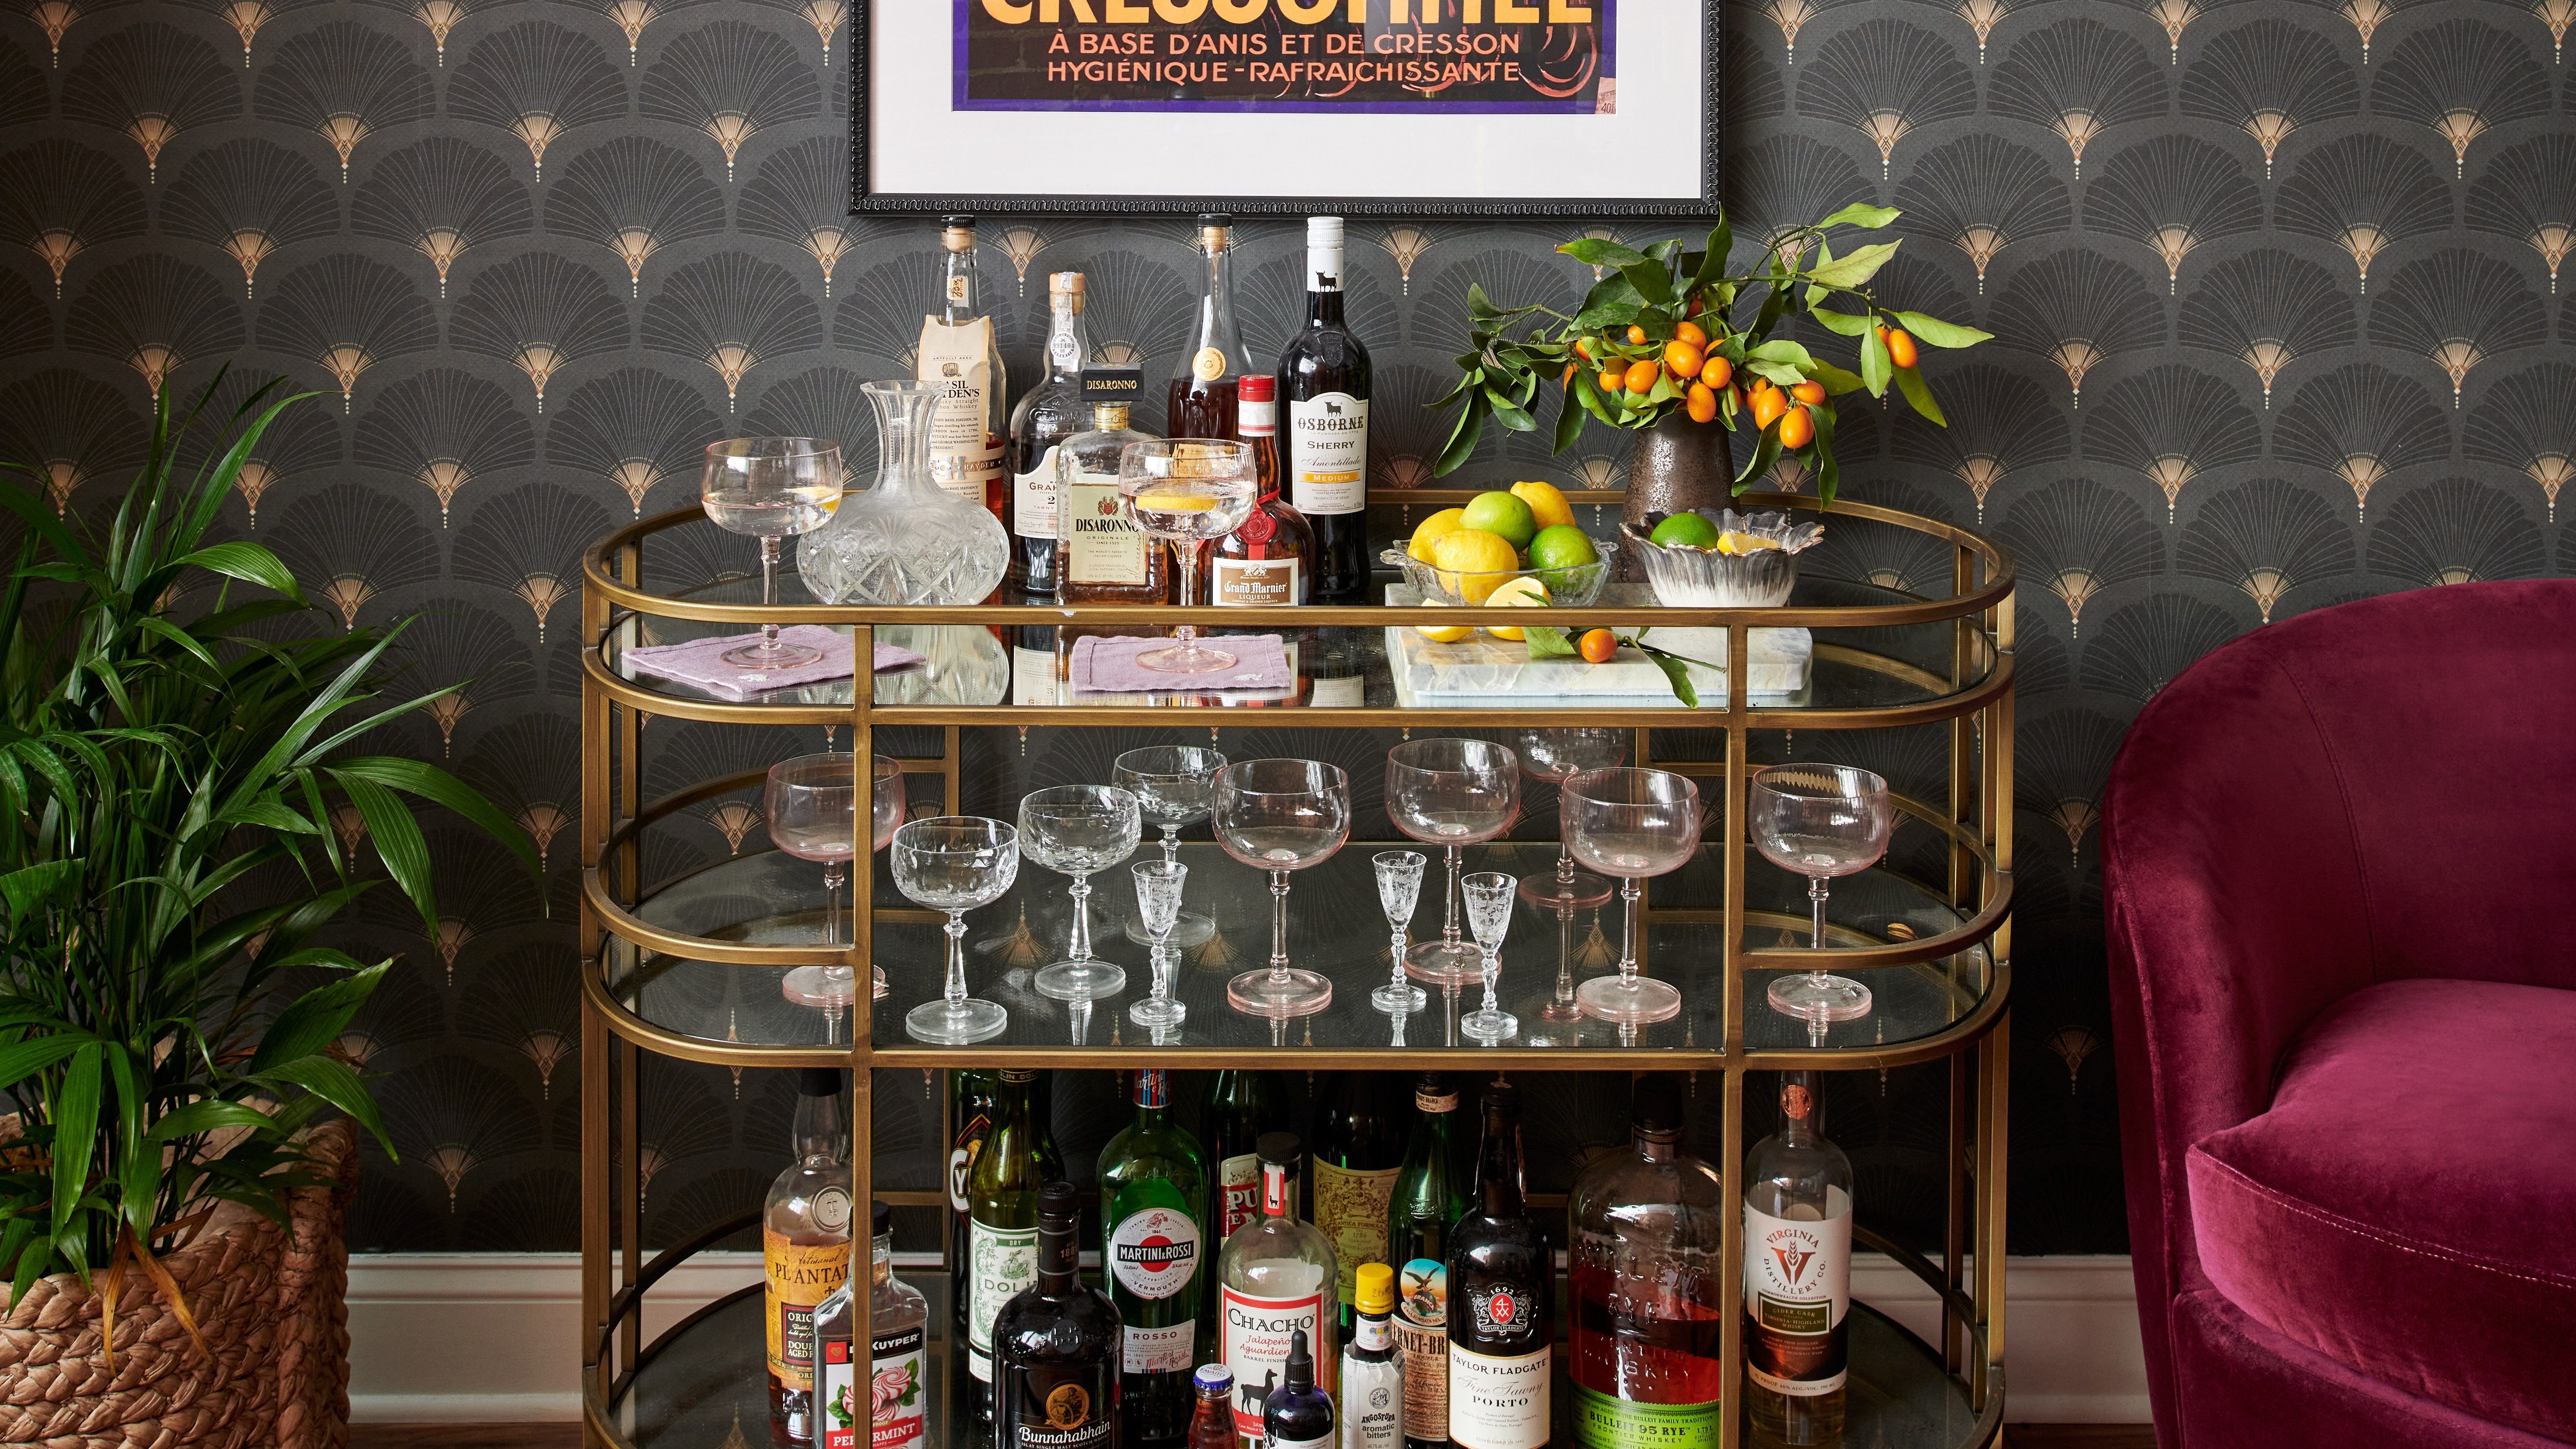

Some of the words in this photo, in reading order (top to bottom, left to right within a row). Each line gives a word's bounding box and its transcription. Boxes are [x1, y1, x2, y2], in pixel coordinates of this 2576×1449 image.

[1048, 28, 1070, 54] À
[1080, 33, 1155, 54] BASE
[1170, 33, 1267, 54] D'ANIS
[1282, 34, 1314, 54] ET
[1326, 34, 1362, 54] DE
[1374, 33, 1519, 54] CRESSON
[946, 380, 969, 389] SIL
[1087, 380, 1138, 390] DISARONNO
[943, 389, 980, 398] DEN'S
[1297, 416, 1364, 431] OSBORNE
[1308, 441, 1355, 449] SHERRY
[964, 461, 995, 470] HAYDEN
[1301, 456, 1361, 467] Amontillado
[1029, 482, 1057, 491] GRAH
[1224, 580, 1250, 594] Grand
[1250, 581, 1287, 594] Marnier
[1766, 1228, 1819, 1249] VIRGINIA
[785, 1248, 842, 1265] Artisanal
[775, 1262, 849, 1284] PLANTAT
[1764, 1258, 1817, 1294] DISTILLERY
[1817, 1261, 1826, 1278] CO.
[1134, 1278, 1179, 1291] VERMOUTH
[1490, 1287, 1514, 1295] 1692
[1762, 1288, 1798, 1300] COMMONWEALTH
[1413, 1294, 1435, 1311] BRANCA
[788, 1312, 813, 1322] ORIG
[1228, 1308, 1314, 1332] CHACHO
[1404, 1306, 1413, 1317] CASA
[1413, 1315, 1432, 1323] FONDATA
[1133, 1331, 1177, 1340] ROSSO
[1246, 1335, 1292, 1347] Jalapeño
[1393, 1322, 1446, 1355] ERNET-BR
[788, 1348, 808, 1358] AGED
[1240, 1343, 1292, 1356] Aguardien
[1243, 1355, 1265, 1363] BARREL
[1452, 1353, 1489, 1375] TAYLOR
[1493, 1358, 1547, 1375] FLADGATE
[1457, 1375, 1490, 1394] Fine
[1493, 1381, 1543, 1397] Tawny
[1760, 1376, 1778, 1386] PROOF
[1473, 1395, 1528, 1407] PORTO
[1361, 1412, 1395, 1424] ANGOSTURA
[1590, 1410, 1635, 1432] BULLEIT
[1639, 1424, 1657, 1435] 95
[1681, 1415, 1713, 1423] TRADITION
[1019, 1421, 1112, 1444] Bunnahabhain
[1362, 1423, 1395, 1432] aromatic
[1593, 1423, 1634, 1440] FRONTIER
[1639, 1435, 1682, 1443] WHISKEY
[1073, 1440, 1093, 1448] SCOTCH
[1476, 1437, 1506, 1445] ESTABLISHED
